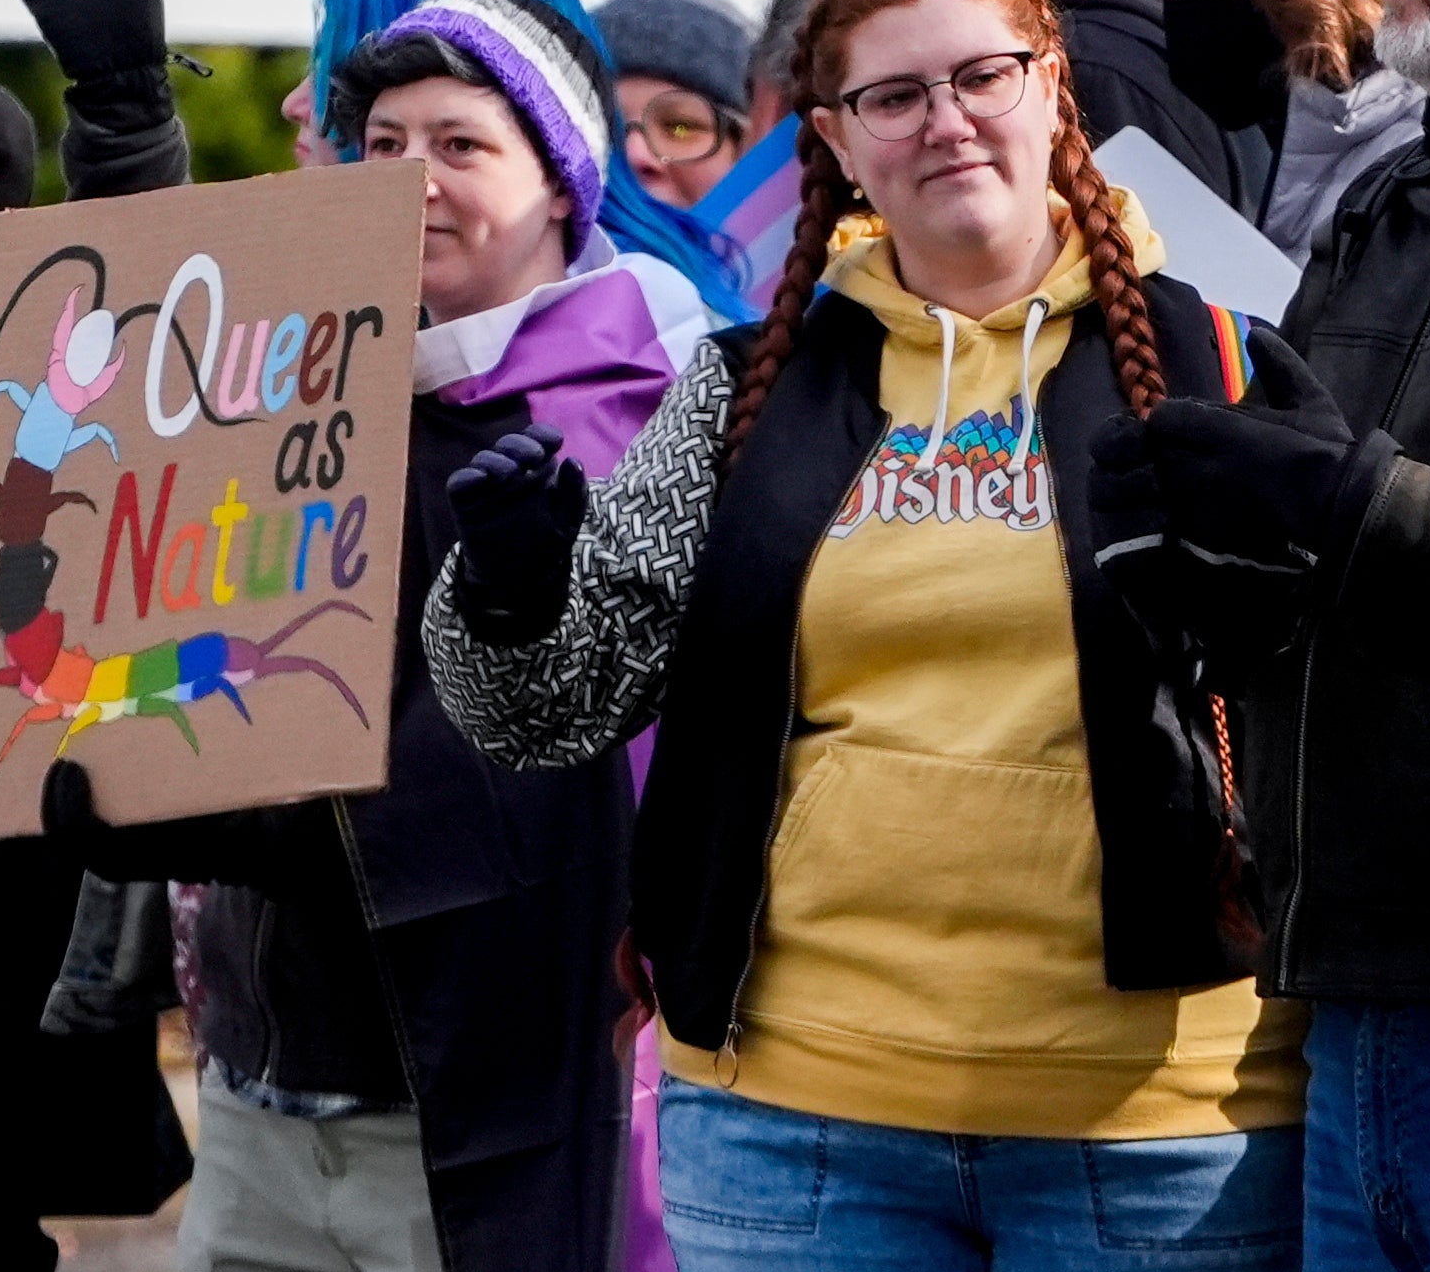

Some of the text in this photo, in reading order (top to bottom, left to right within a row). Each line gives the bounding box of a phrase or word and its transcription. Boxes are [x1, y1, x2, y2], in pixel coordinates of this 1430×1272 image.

[144, 251, 384, 437] Queer
[274, 409, 354, 494] as
[93, 462, 369, 624] Nature
